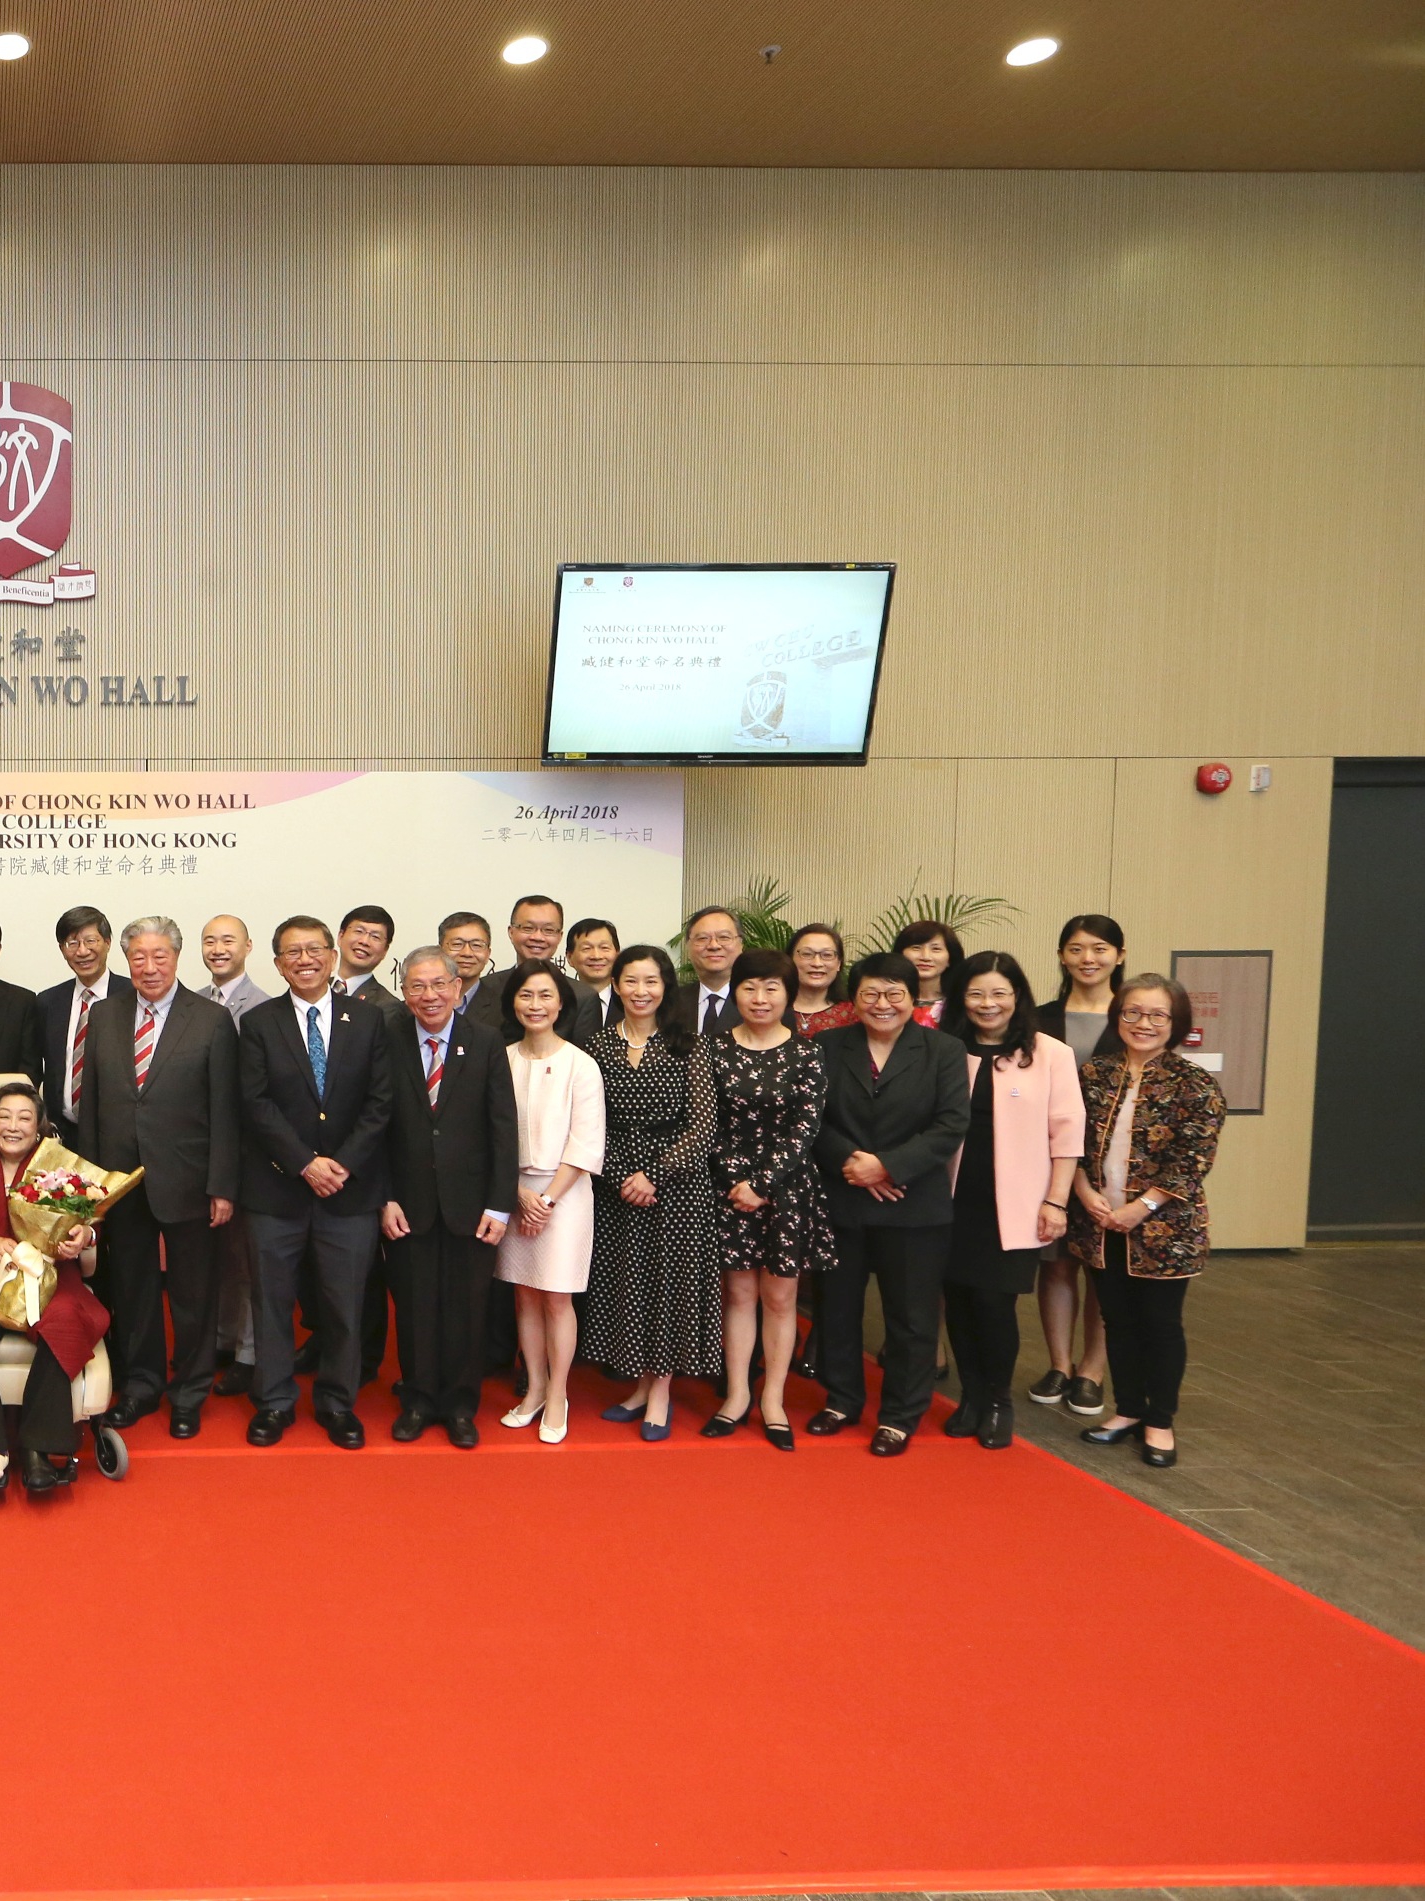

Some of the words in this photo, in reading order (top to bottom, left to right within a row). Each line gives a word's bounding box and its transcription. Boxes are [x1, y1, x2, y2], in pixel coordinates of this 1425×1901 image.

[2, 585, 50, 598] Beneficentia
[582, 624, 635, 634] NAMING
[637, 624, 709, 634] CEREMONY
[710, 624, 728, 633] OF
[588, 636, 634, 645] CHONG
[636, 636, 658, 645] KIN
[662, 636, 683, 645] WO
[686, 635, 719, 645] HALL
[762, 630, 863, 668] COLLEGE
[31, 675, 89, 706] WO
[100, 675, 199, 707] HALL
[619, 683, 630, 691] 26
[632, 683, 656, 693] April
[659, 683, 682, 691] 2018
[22, 793, 102, 810] CHONG
[108, 793, 147, 810] KIN
[153, 793, 191, 810] WO
[196, 793, 257, 809] HALL
[2, 813, 107, 830] COLLEGE
[514, 805, 534, 820] 26
[536, 805, 579, 825] April
[580, 805, 619, 820] 2018
[68, 833, 98, 849] OF
[103, 832, 167, 849] HONG
[173, 832, 238, 849] KONG
[481, 826, 654, 843] 二零一八年四月二十六日
